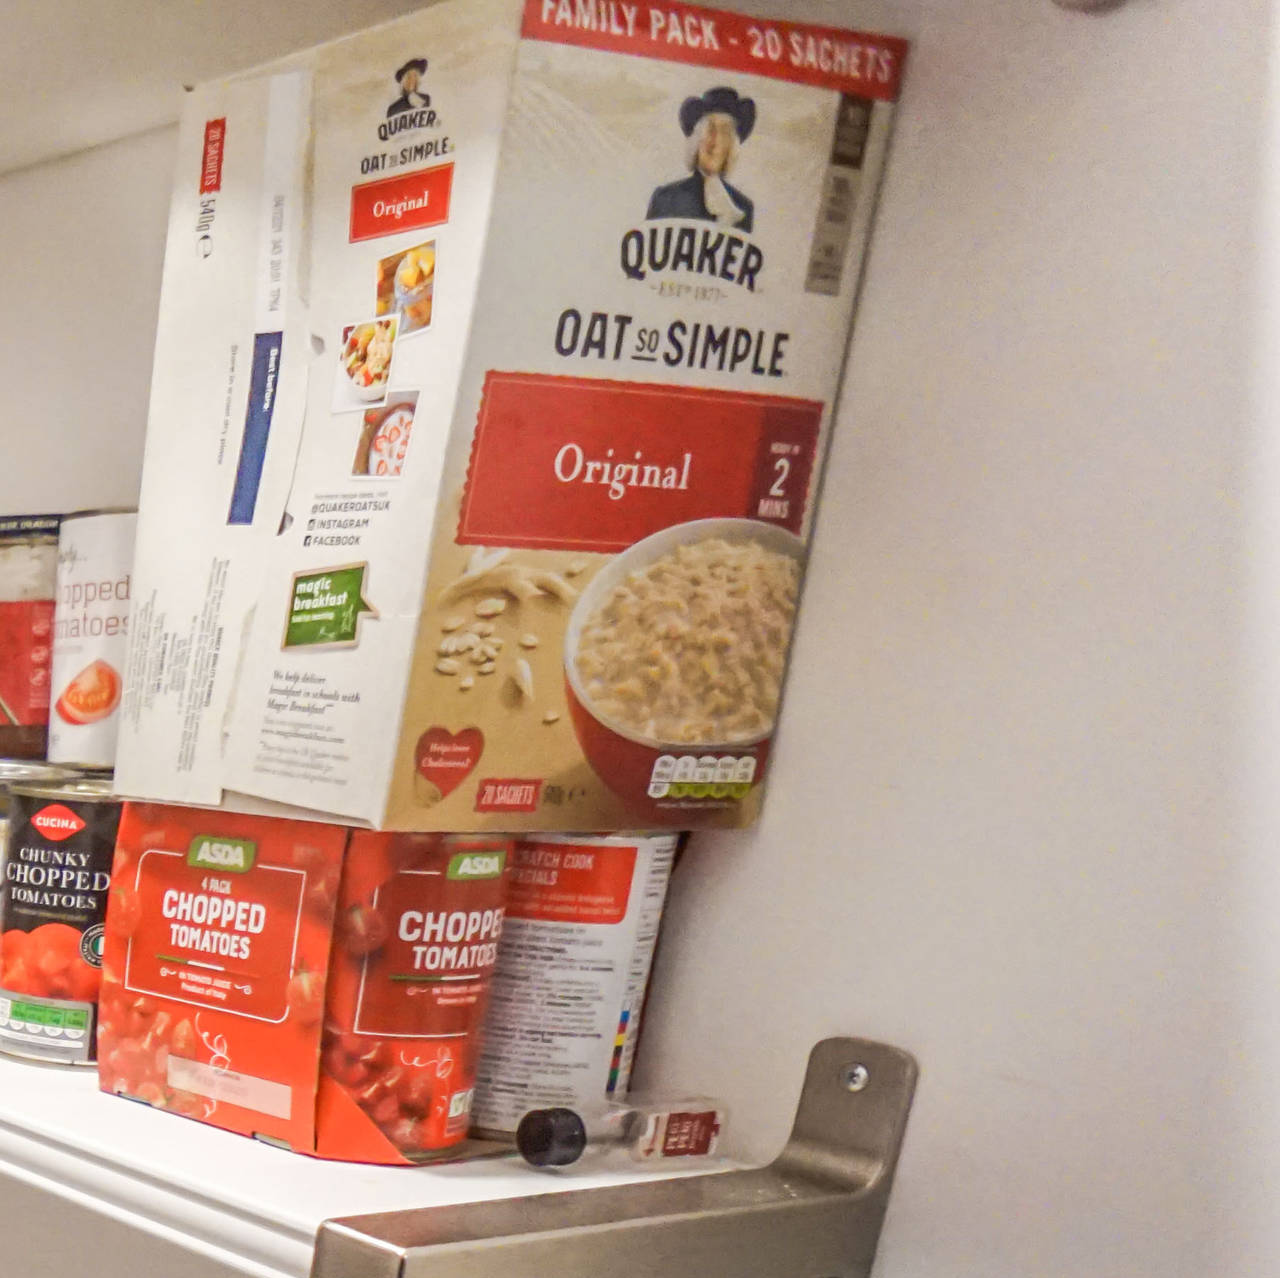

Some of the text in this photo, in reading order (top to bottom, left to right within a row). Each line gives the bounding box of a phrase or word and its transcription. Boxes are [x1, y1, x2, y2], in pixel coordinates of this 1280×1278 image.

[540, 0, 636, 37] FAMILY
[649, 9, 719, 50] PACK
[746, 27, 783, 60] 20
[789, 33, 893, 83] SACHETS
[378, 110, 436, 141] QUAKER
[361, 153, 386, 174] OAT
[400, 137, 448, 165] SIMPLE
[196, 199, 216, 232] 540g
[373, 190, 429, 219] Original
[620, 227, 763, 292] QUAKER
[554, 308, 790, 377] OAT SO SIMPLE
[554, 443, 692, 500] Original
[769, 458, 790, 496] 2
[758, 498, 790, 519] MINS
[316, 518, 369, 530] INSTAGRAM
[313, 535, 361, 546] FACEBOOK
[296, 577, 332, 597] magic
[293, 592, 348, 612] breakfast
[35, 816, 78, 830] CUCINA
[19, 847, 91, 867] CHUNKY
[196, 841, 245, 868] ASDA
[458, 855, 500, 876] ASDA
[563, 853, 595, 870] COOK
[6, 862, 111, 892] CHOPPED
[201, 876, 208, 890] 4
[10, 886, 98, 910] TOMATOES
[162, 889, 267, 934] CHOPPED
[398, 907, 506, 943] CHOPPE
[170, 923, 251, 960] TOMATOES
